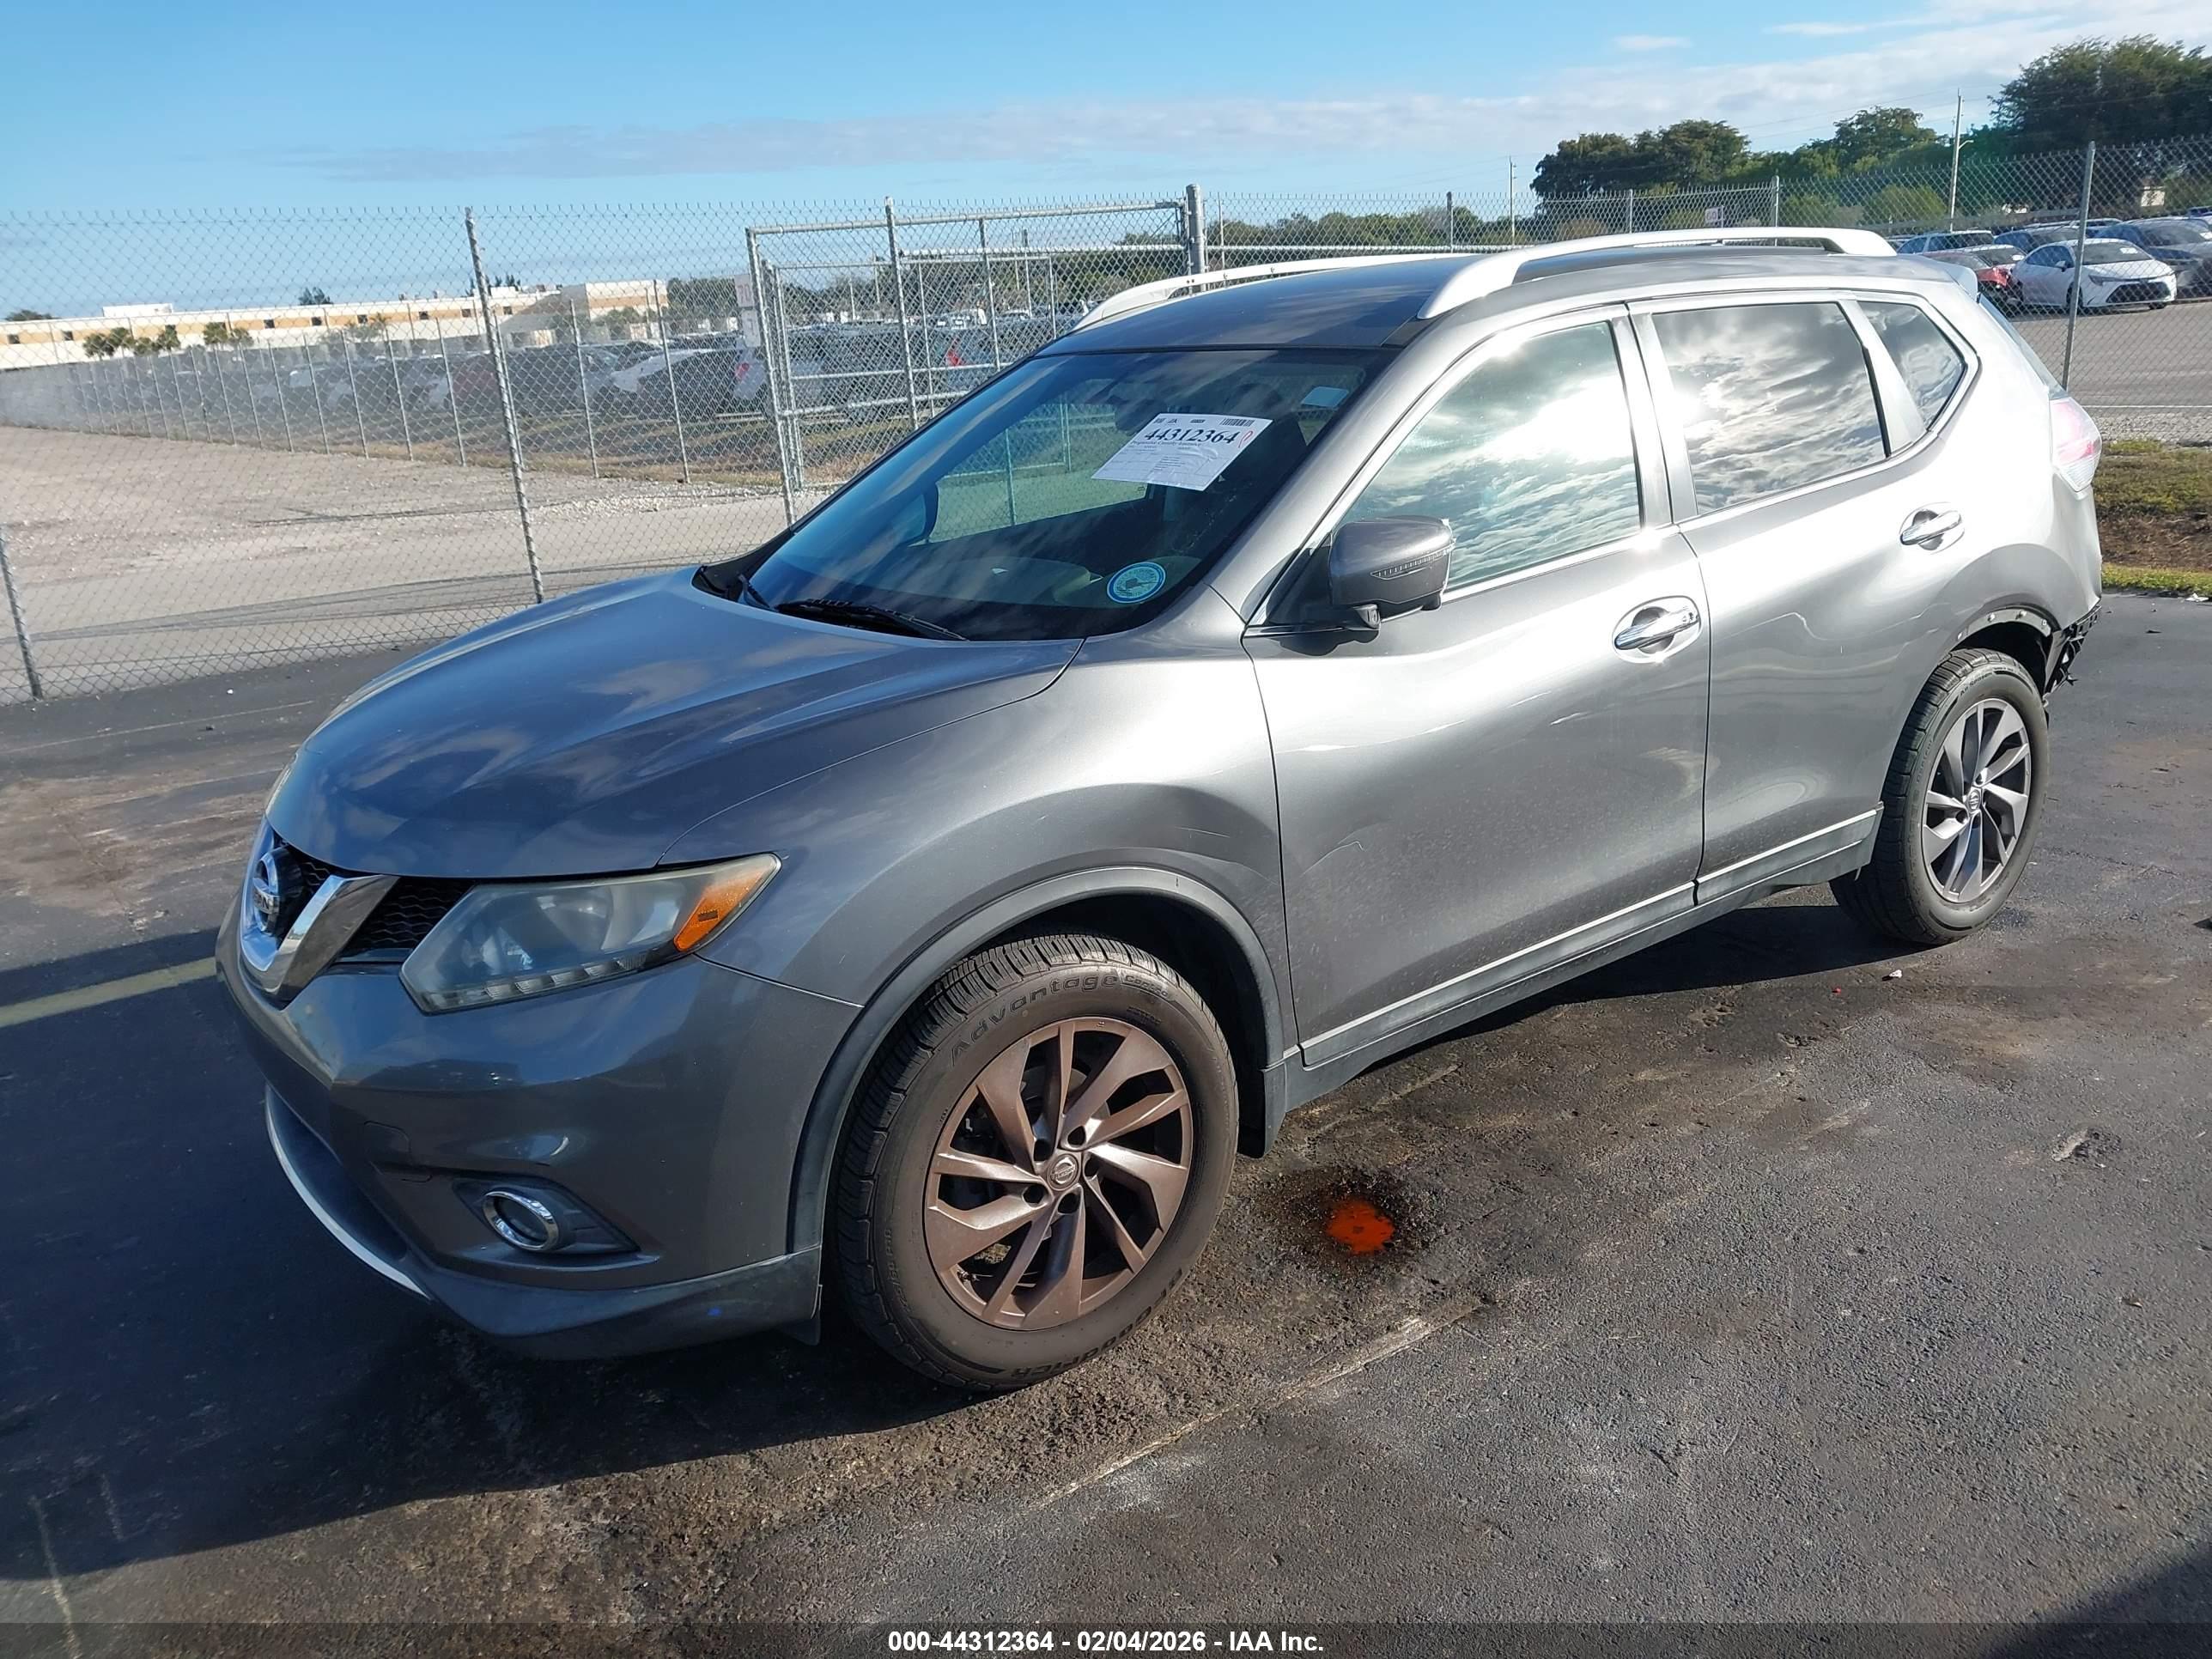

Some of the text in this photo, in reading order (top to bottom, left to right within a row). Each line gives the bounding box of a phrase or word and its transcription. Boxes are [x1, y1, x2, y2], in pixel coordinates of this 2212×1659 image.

[1144, 428, 1241, 445] 44312364
[951, 974, 1120, 1067] Advantage
[1125, 975, 1170, 999] Contro
